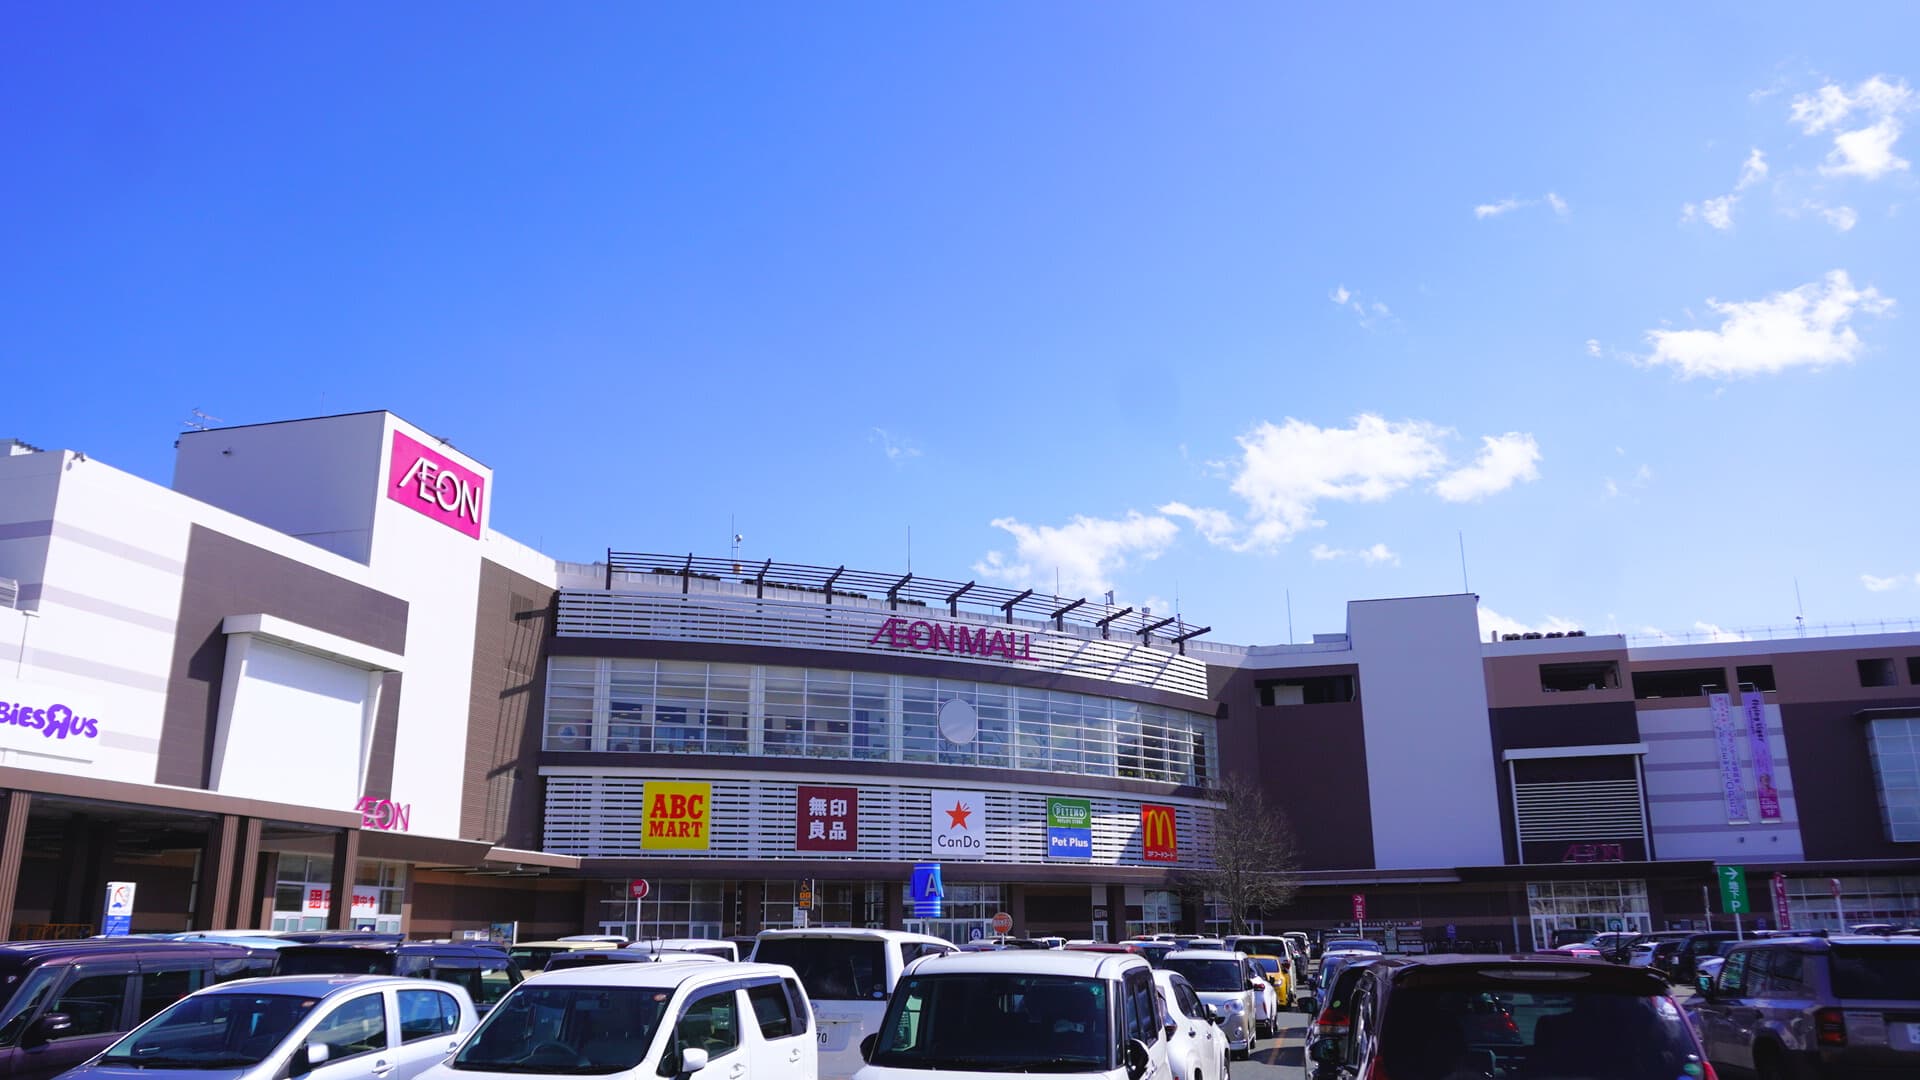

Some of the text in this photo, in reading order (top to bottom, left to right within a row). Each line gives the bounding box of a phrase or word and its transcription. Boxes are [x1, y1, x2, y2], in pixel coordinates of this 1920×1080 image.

[959, 626, 1040, 662] MALL
[650, 794, 703, 819] ABC
[809, 797, 847, 817] 無印
[649, 821, 702, 838] MART
[808, 820, 847, 840] 良品
[937, 834, 981, 848] CanDo
[1051, 836, 1089, 848] Pet Plus
[925, 873, 939, 897] A
